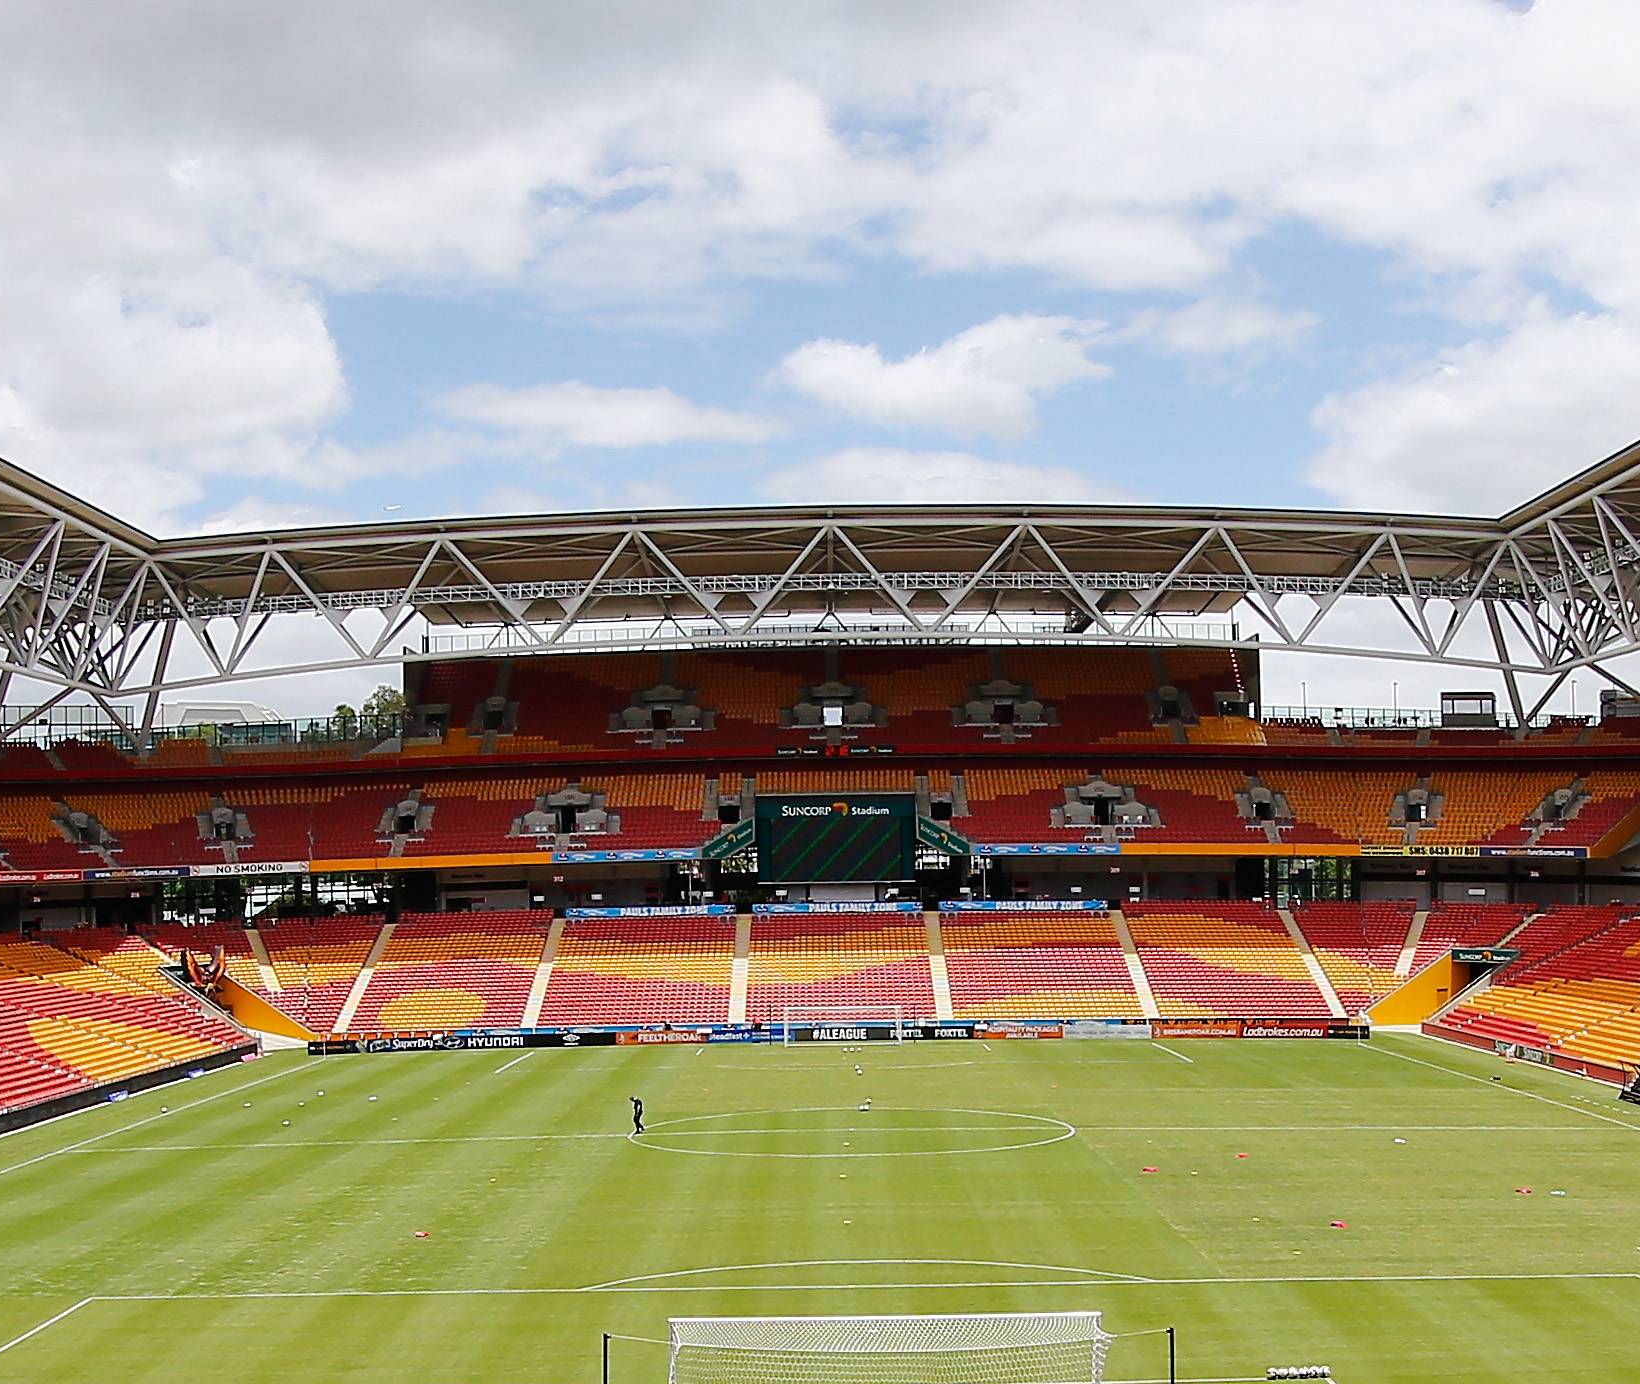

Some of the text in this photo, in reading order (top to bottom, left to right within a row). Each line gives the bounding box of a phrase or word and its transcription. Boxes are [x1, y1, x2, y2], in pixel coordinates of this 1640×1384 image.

[782, 805, 890, 817] SUNCORP Stadium
[216, 863, 284, 874] NO SMOKING
[620, 905, 708, 917] PAULS FAMILY ZONE
[809, 903, 898, 913] PAULS FAMILY ZONE
[996, 901, 1084, 911] PAULS FAMILY ZONE
[812, 1028, 867, 1040] #ALEAGUE
[890, 1030, 923, 1038] FXTEL
[935, 1029, 968, 1037] FOXTEL
[1242, 1026, 1324, 1037] Ladbrokes.com.au
[467, 1037, 523, 1048] HYUNDAI
